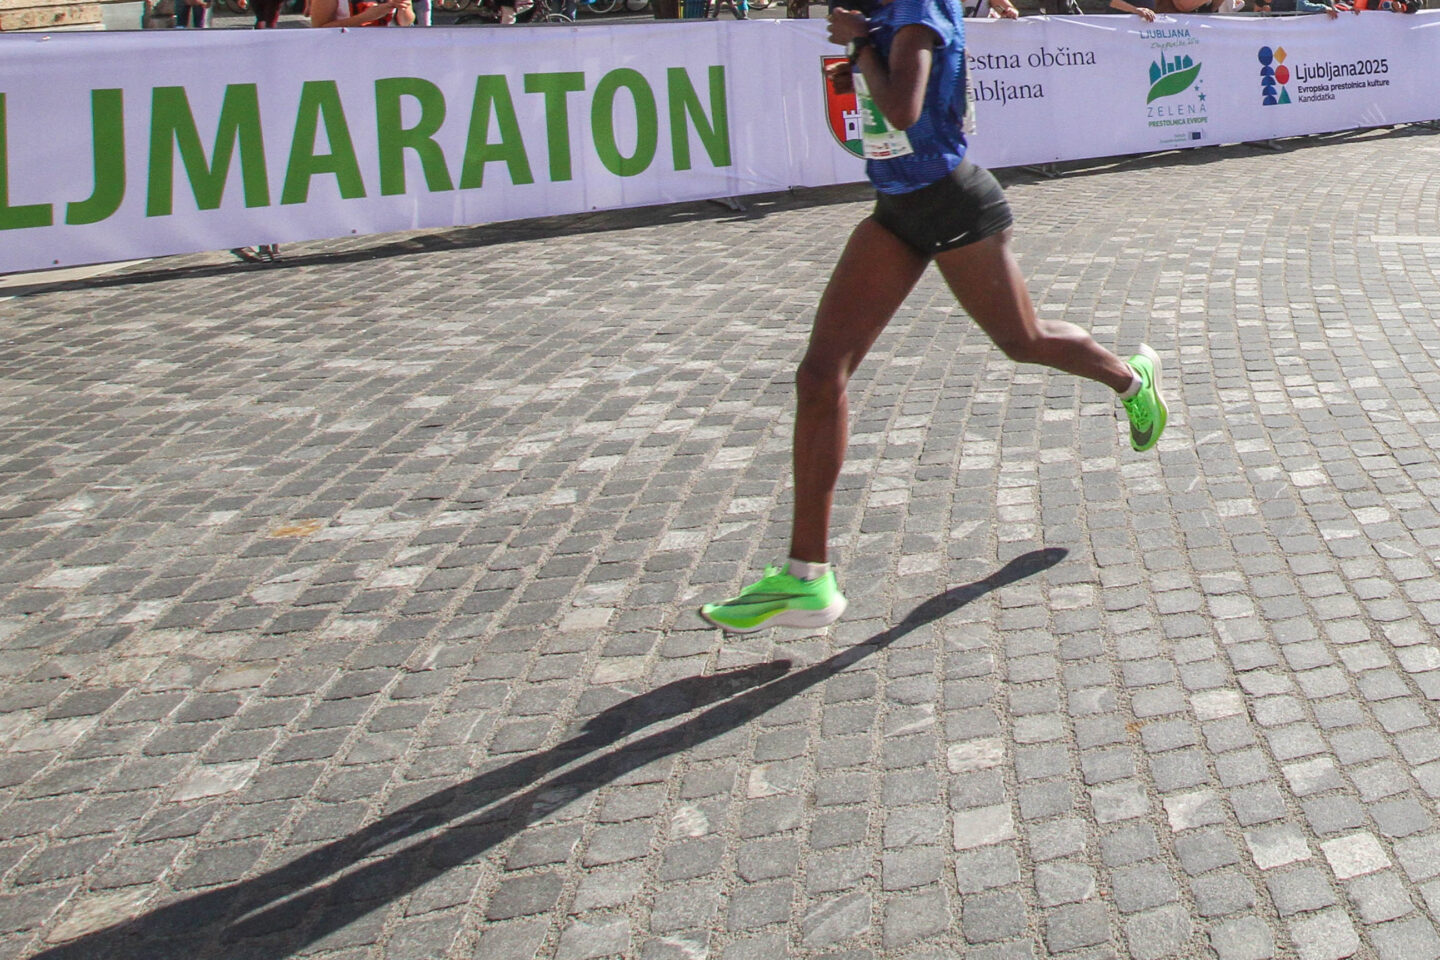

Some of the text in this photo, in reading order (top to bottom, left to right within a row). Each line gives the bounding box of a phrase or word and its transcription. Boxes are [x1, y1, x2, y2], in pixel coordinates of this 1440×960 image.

[1140, 29, 1191, 39] LJUBLJANA
[968, 47, 1096, 70] estna občina
[1295, 59, 1389, 83] Ljubljana2025
[970, 80, 1044, 107] ubljana
[1298, 78, 1390, 94] Evropska prestolnica kulture
[1298, 93, 1335, 103] Kandidatka
[1147, 103, 1207, 118] ZELENA
[1149, 116, 1208, 128] PRESTOLNICA EVROPE
